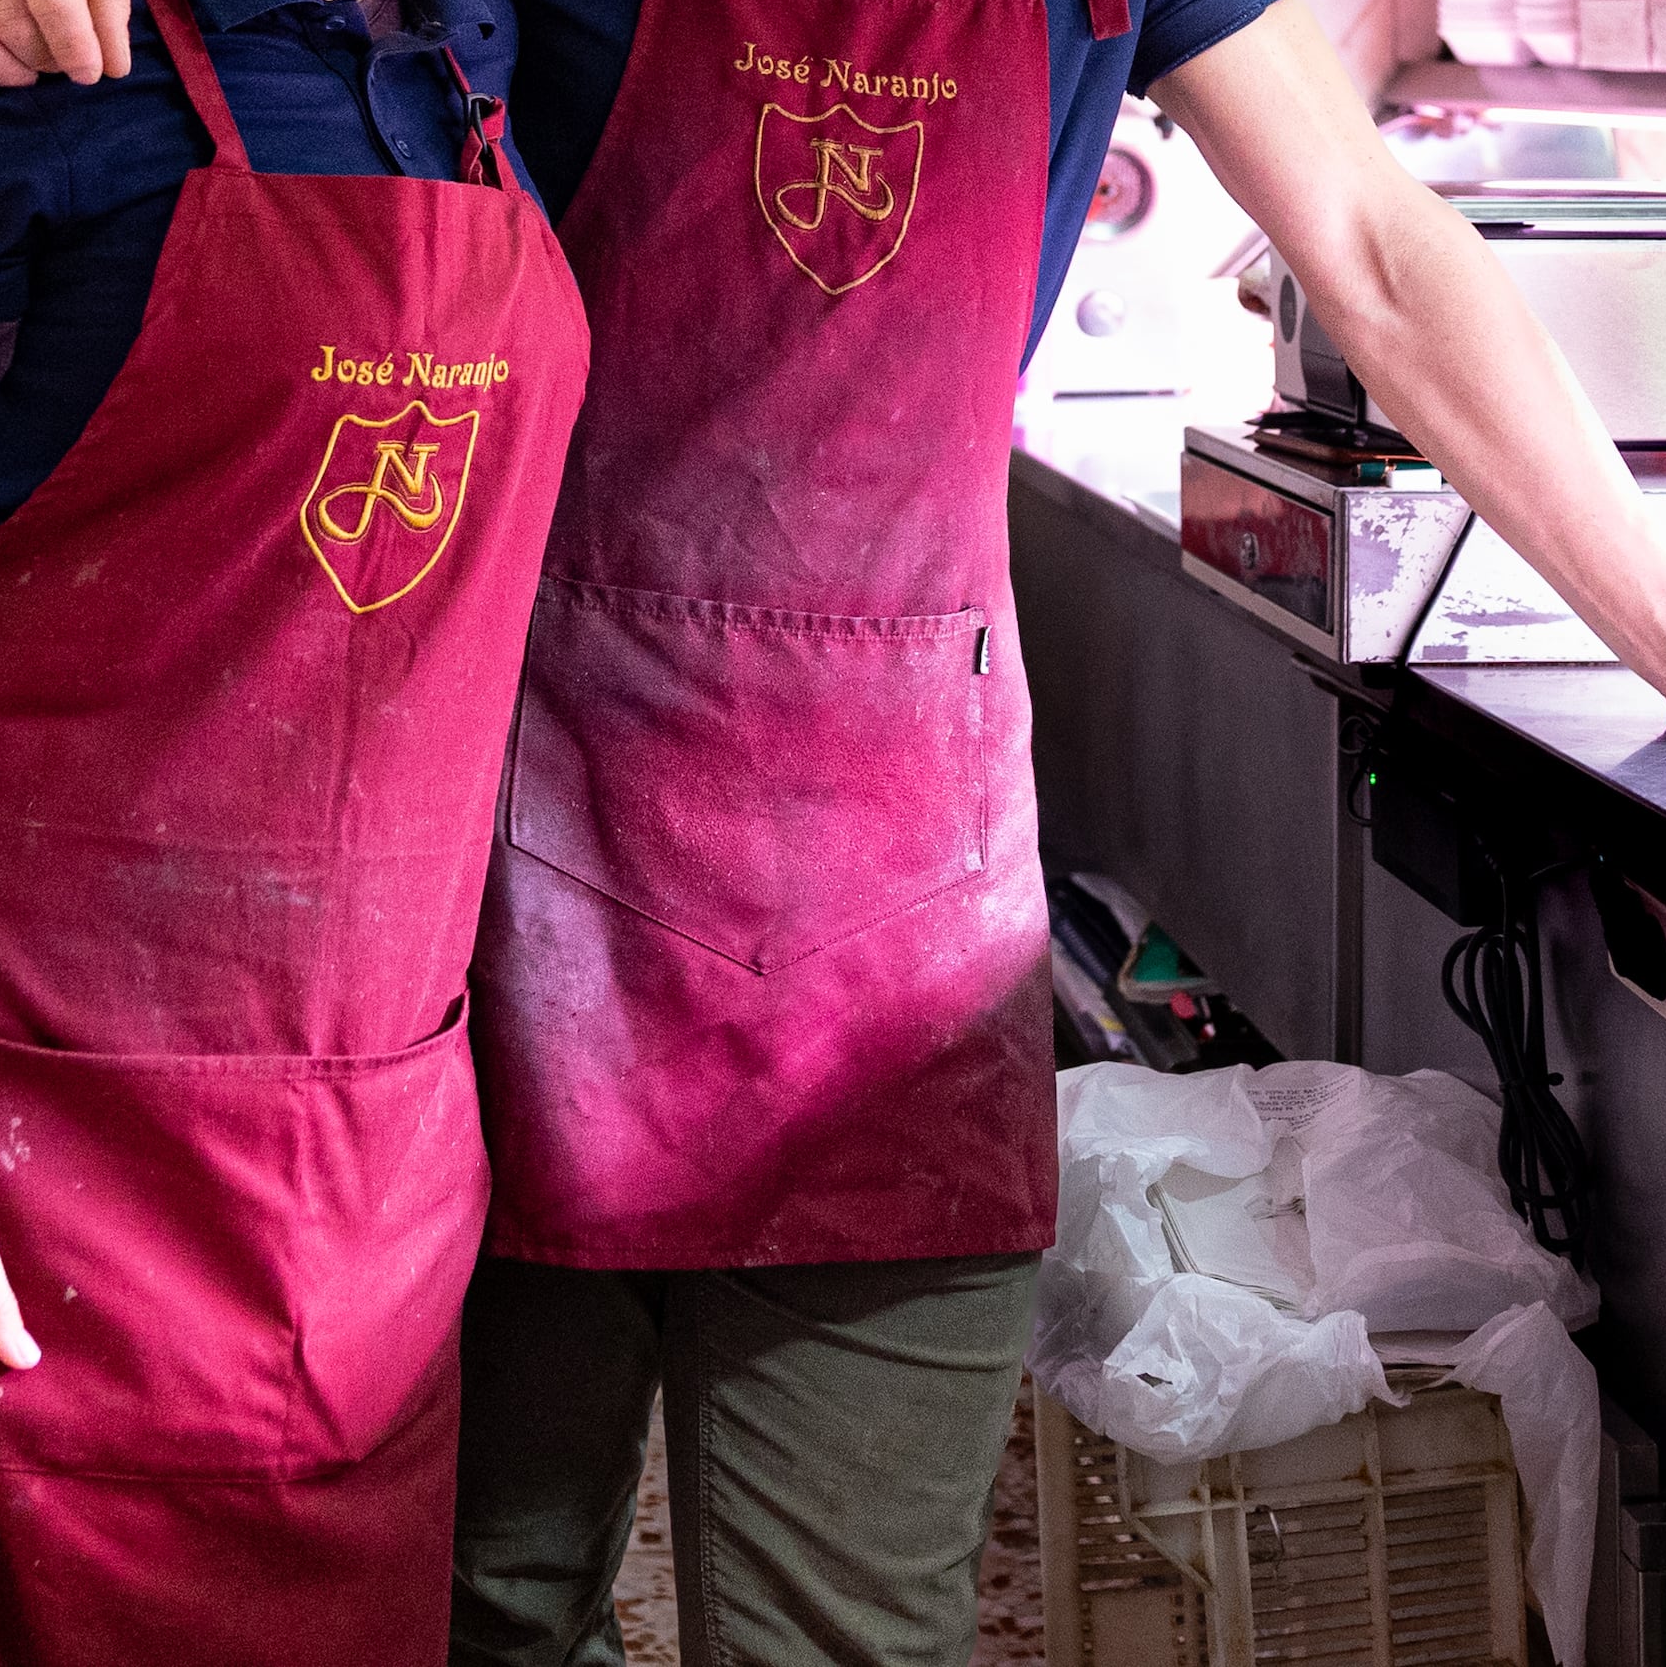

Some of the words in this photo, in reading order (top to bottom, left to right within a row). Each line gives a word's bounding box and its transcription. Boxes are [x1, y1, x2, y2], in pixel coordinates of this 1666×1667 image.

[733, 41, 811, 84] José
[819, 57, 958, 105] Naranjo
[310, 344, 395, 387] José
[401, 351, 510, 393] Naranjo
